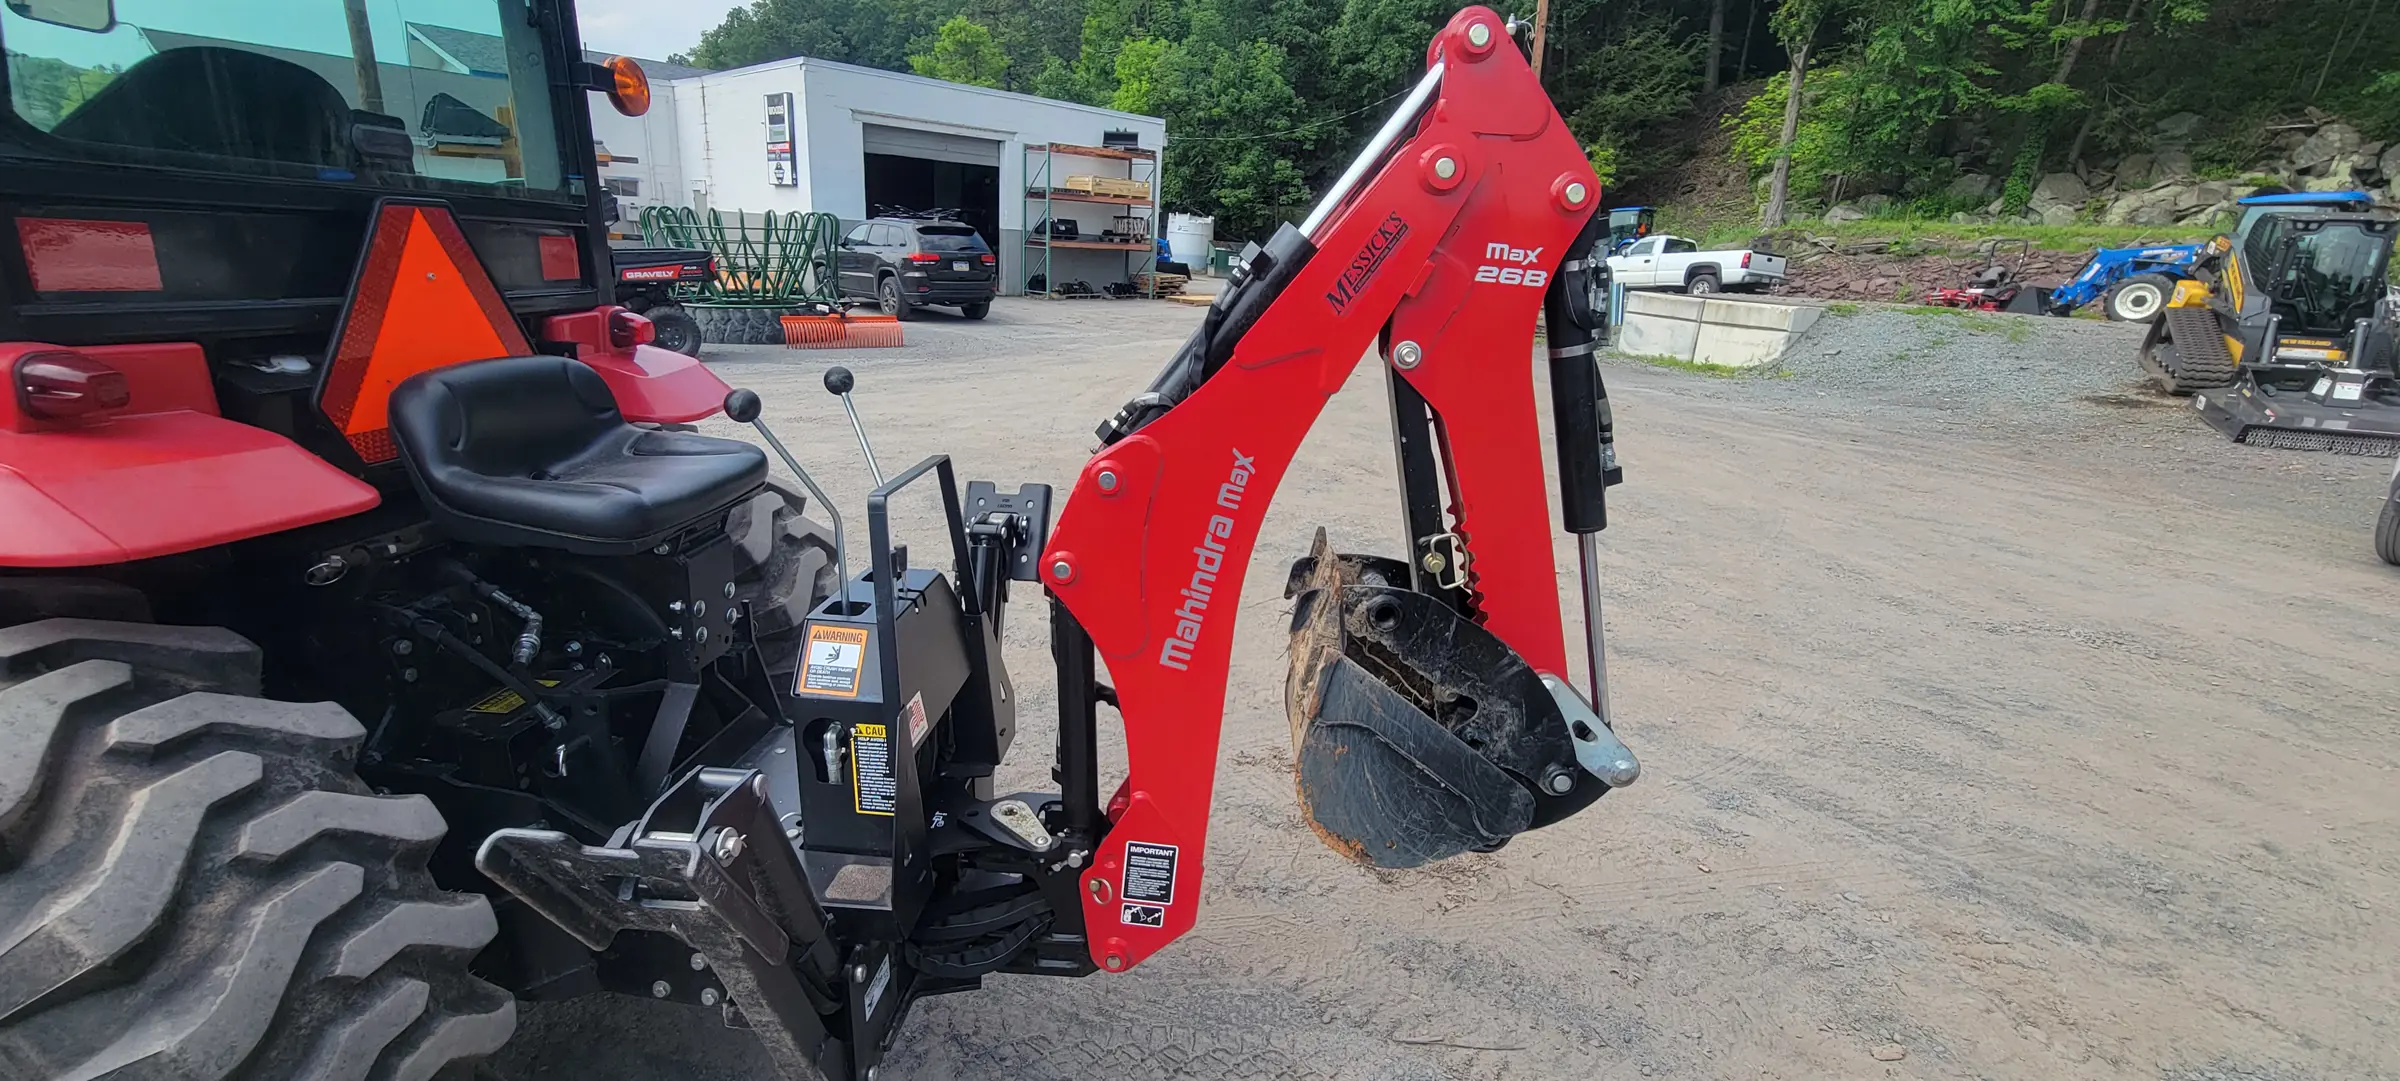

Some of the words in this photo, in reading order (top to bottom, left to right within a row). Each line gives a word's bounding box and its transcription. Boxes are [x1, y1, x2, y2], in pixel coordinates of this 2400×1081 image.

[1325, 211, 1402, 316] MESSICK'S
[626, 271, 674, 279] GRAVELY
[1474, 266, 1548, 287] 26B
[1159, 514, 1235, 672] Mahindra
[823, 630, 863, 643] WARNING
[866, 726, 886, 736] CAU
[1130, 846, 1175, 857] IMPORTANT
